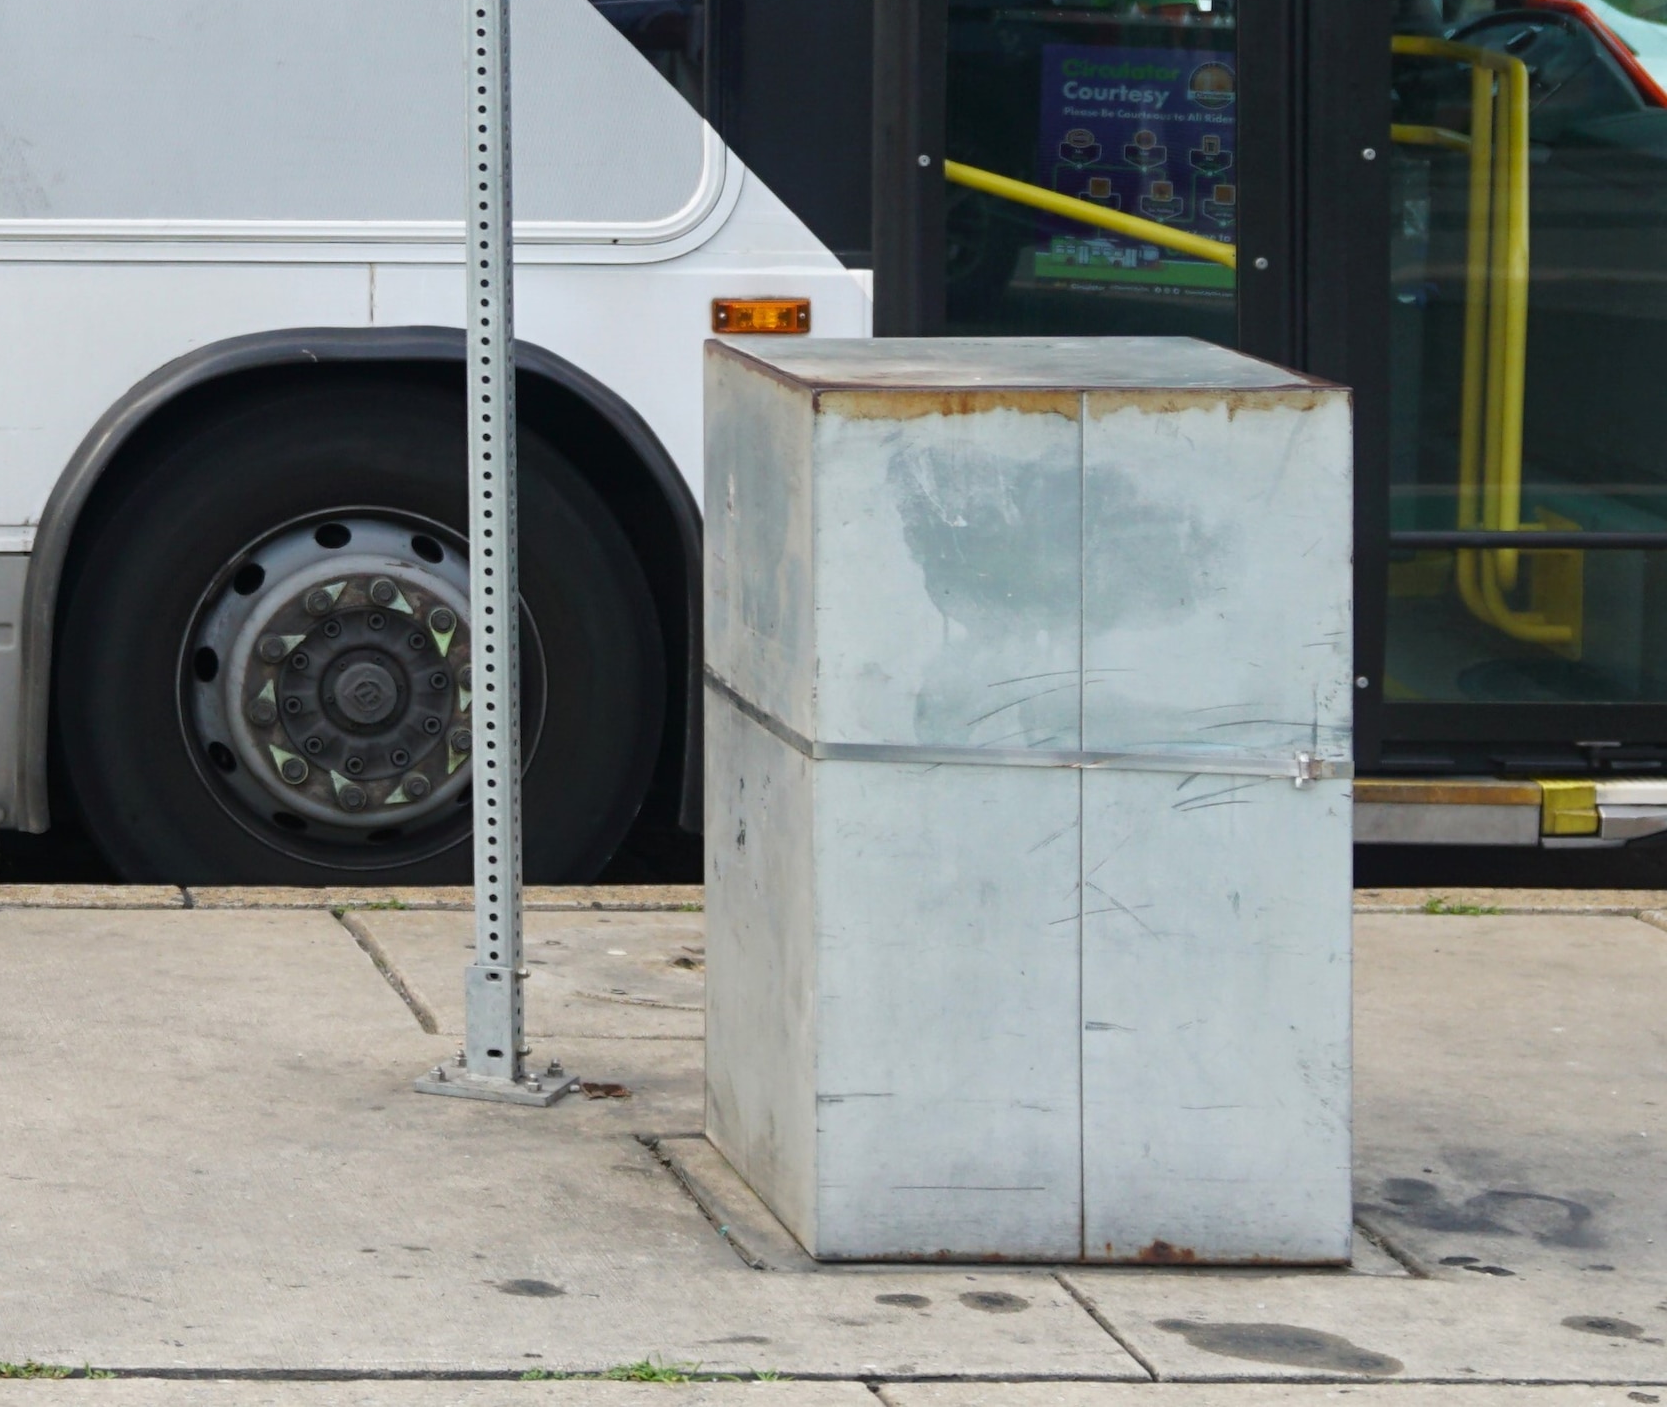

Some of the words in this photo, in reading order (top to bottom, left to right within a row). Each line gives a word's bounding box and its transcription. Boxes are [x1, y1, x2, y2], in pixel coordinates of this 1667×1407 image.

[1062, 58, 1180, 82] Circulator
[1063, 81, 1170, 109] Courtesy
[1064, 106, 1098, 117] Please
[1101, 109, 1115, 118] Be
[1117, 109, 1171, 121] Courteous
[1174, 112, 1185, 121] to
[1188, 112, 1202, 122] All
[1205, 113, 1234, 124] Rider
